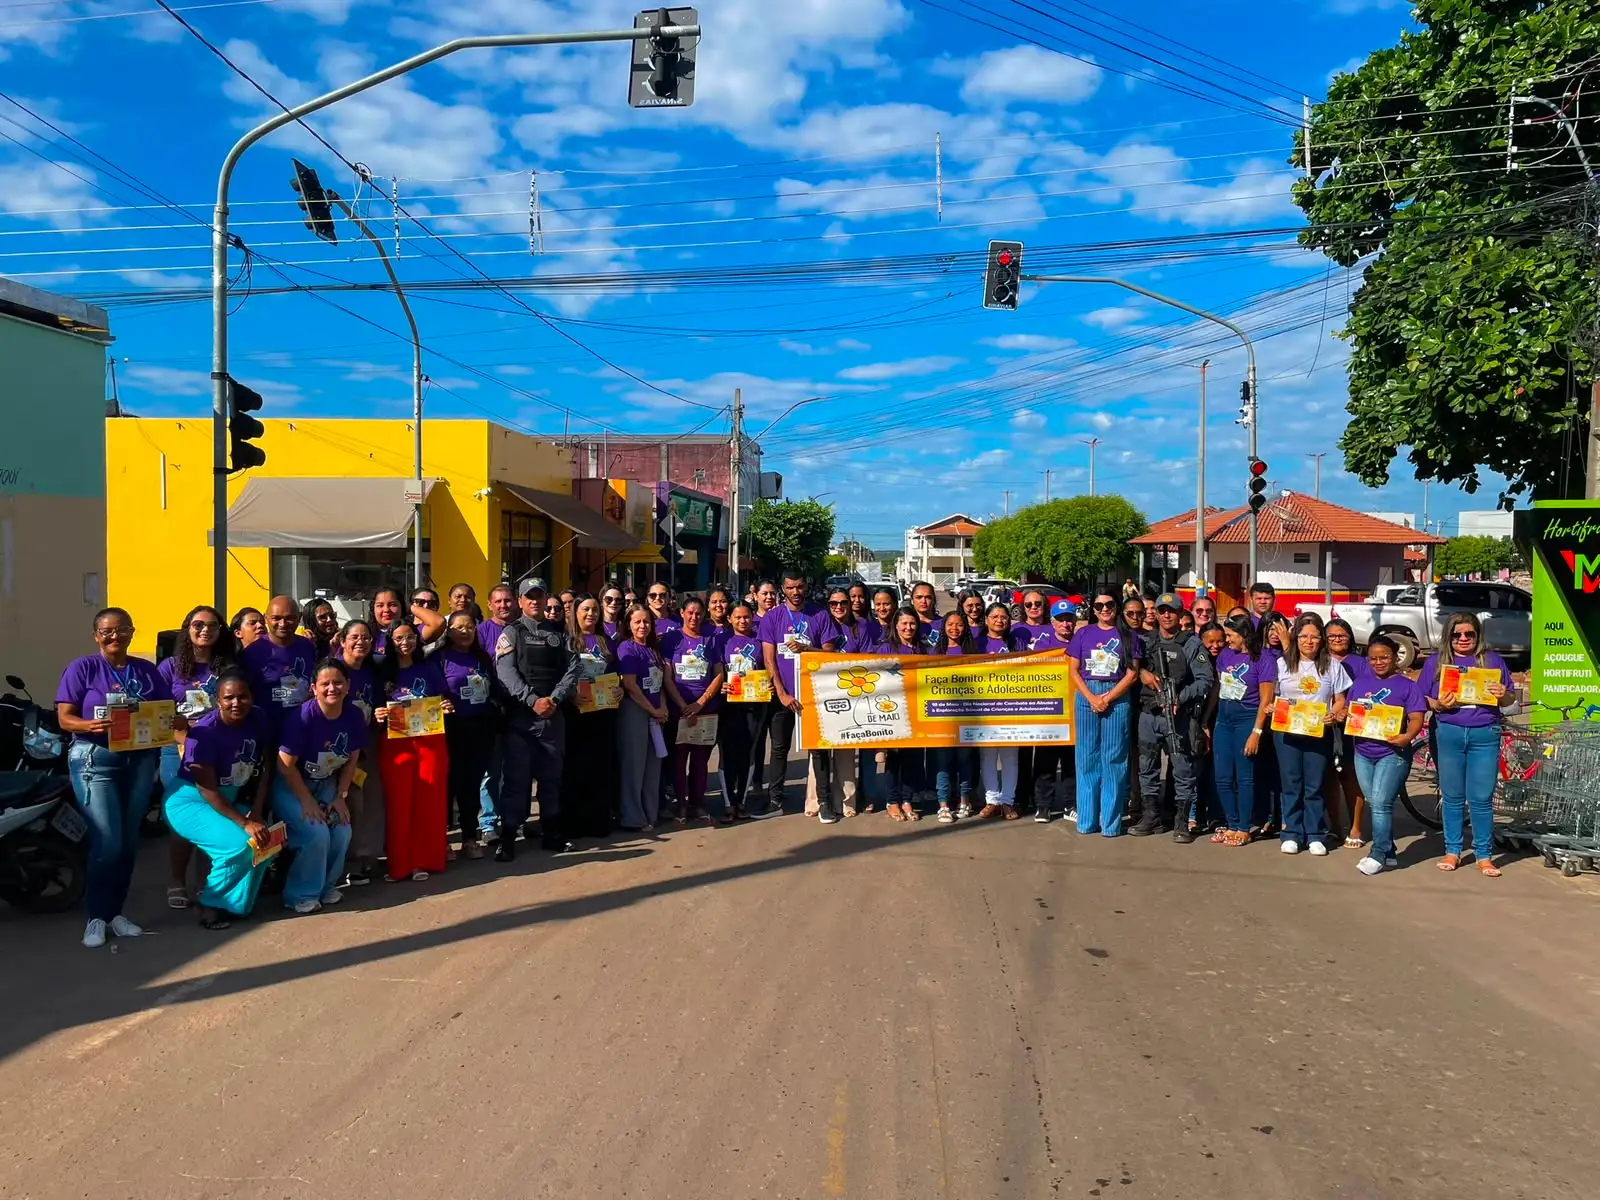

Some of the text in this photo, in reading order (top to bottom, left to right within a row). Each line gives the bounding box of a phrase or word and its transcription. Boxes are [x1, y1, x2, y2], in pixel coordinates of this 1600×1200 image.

[1544, 622, 1564, 631] AQUI
[1544, 638, 1573, 646] TEMOS
[1544, 653, 1585, 663] AÇOUGUE
[1543, 669, 1592, 678] HORTIFRUTI
[925, 673, 1062, 685] Faça Bonito. Proteja nossas
[931, 685, 976, 696] Crianças
[987, 684, 1056, 694] Adolescentes.
[867, 713, 900, 723] DE MAIO
[841, 729, 894, 740] #FaçaBonito
